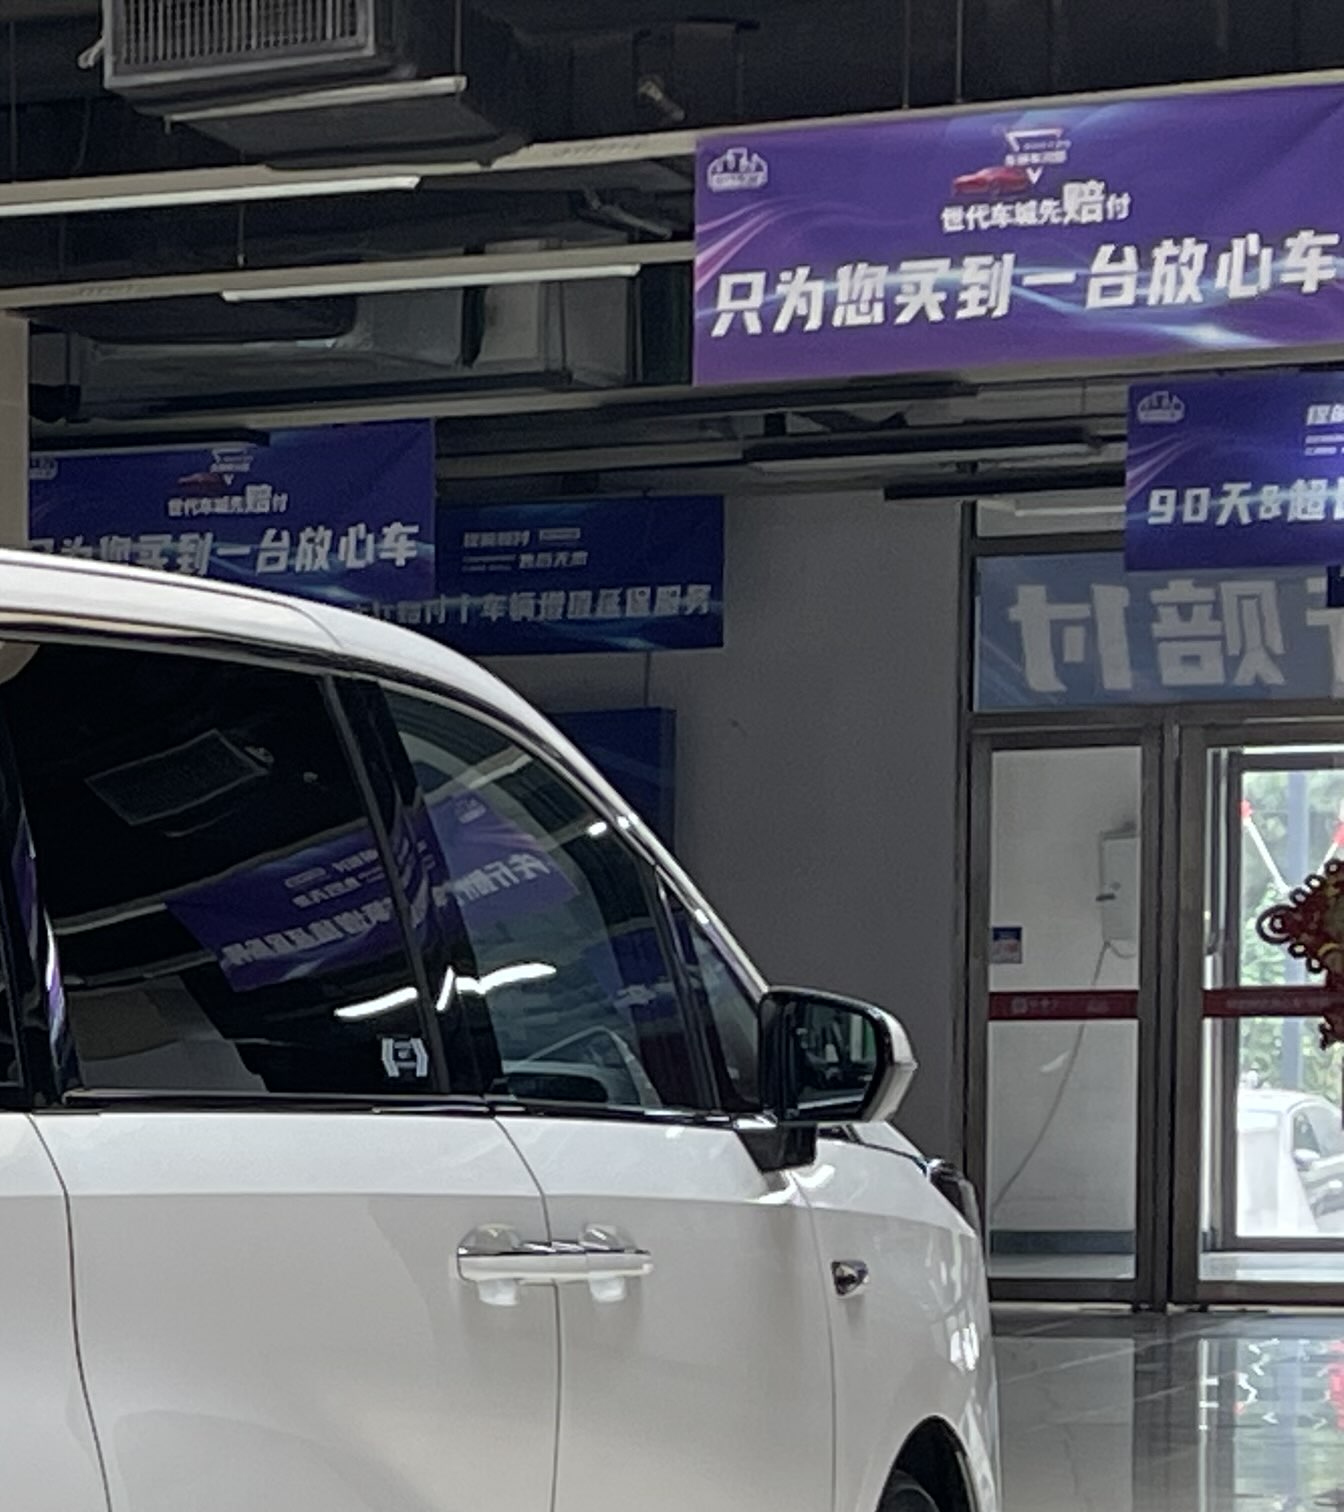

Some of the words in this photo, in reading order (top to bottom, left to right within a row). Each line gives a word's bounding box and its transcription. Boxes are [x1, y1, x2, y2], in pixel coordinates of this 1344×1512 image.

[711, 229, 1341, 337] 只为您买到一台放心车
